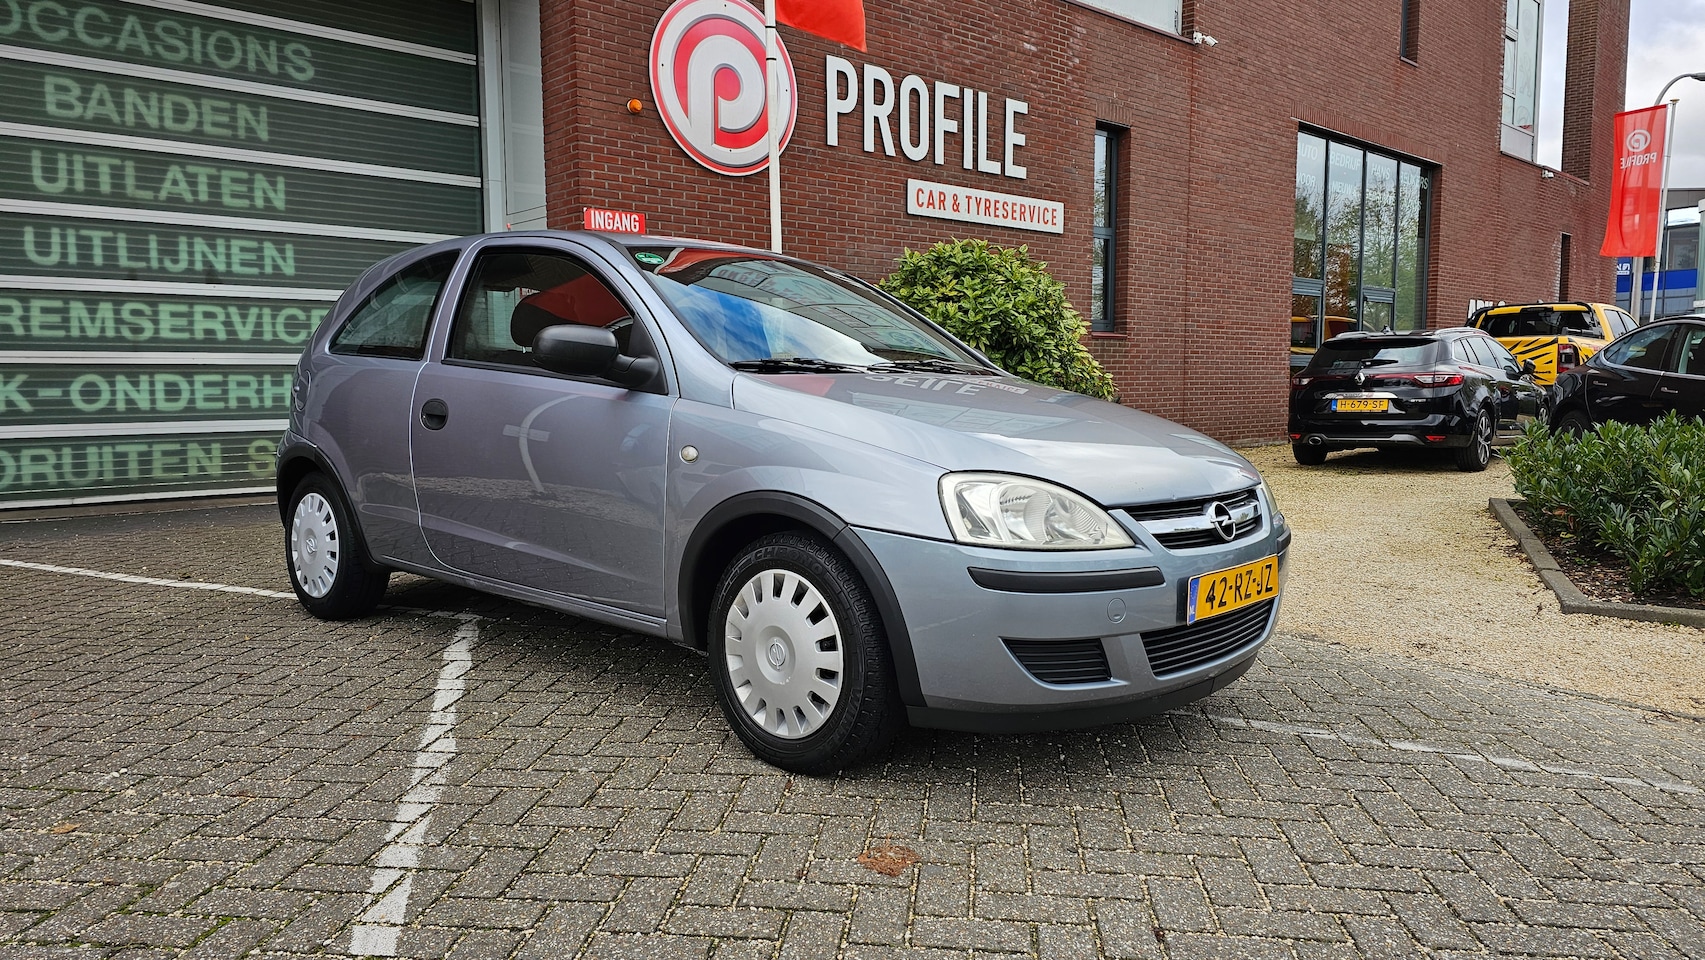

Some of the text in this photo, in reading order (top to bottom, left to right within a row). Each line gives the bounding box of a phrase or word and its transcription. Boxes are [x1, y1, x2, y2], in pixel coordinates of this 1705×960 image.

[44, 74, 270, 143] BANDEN
[826, 55, 1029, 180] PROFILE
[31, 149, 286, 212] UITLATEN
[591, 210, 640, 233] INGANG
[916, 188, 1057, 227] CAR & TYRESERVICE
[23, 226, 296, 276] UITLIJNEN
[1340, 400, 1385, 410] H-679-SF
[1206, 563, 1273, 610] 42-RZ-JZ
